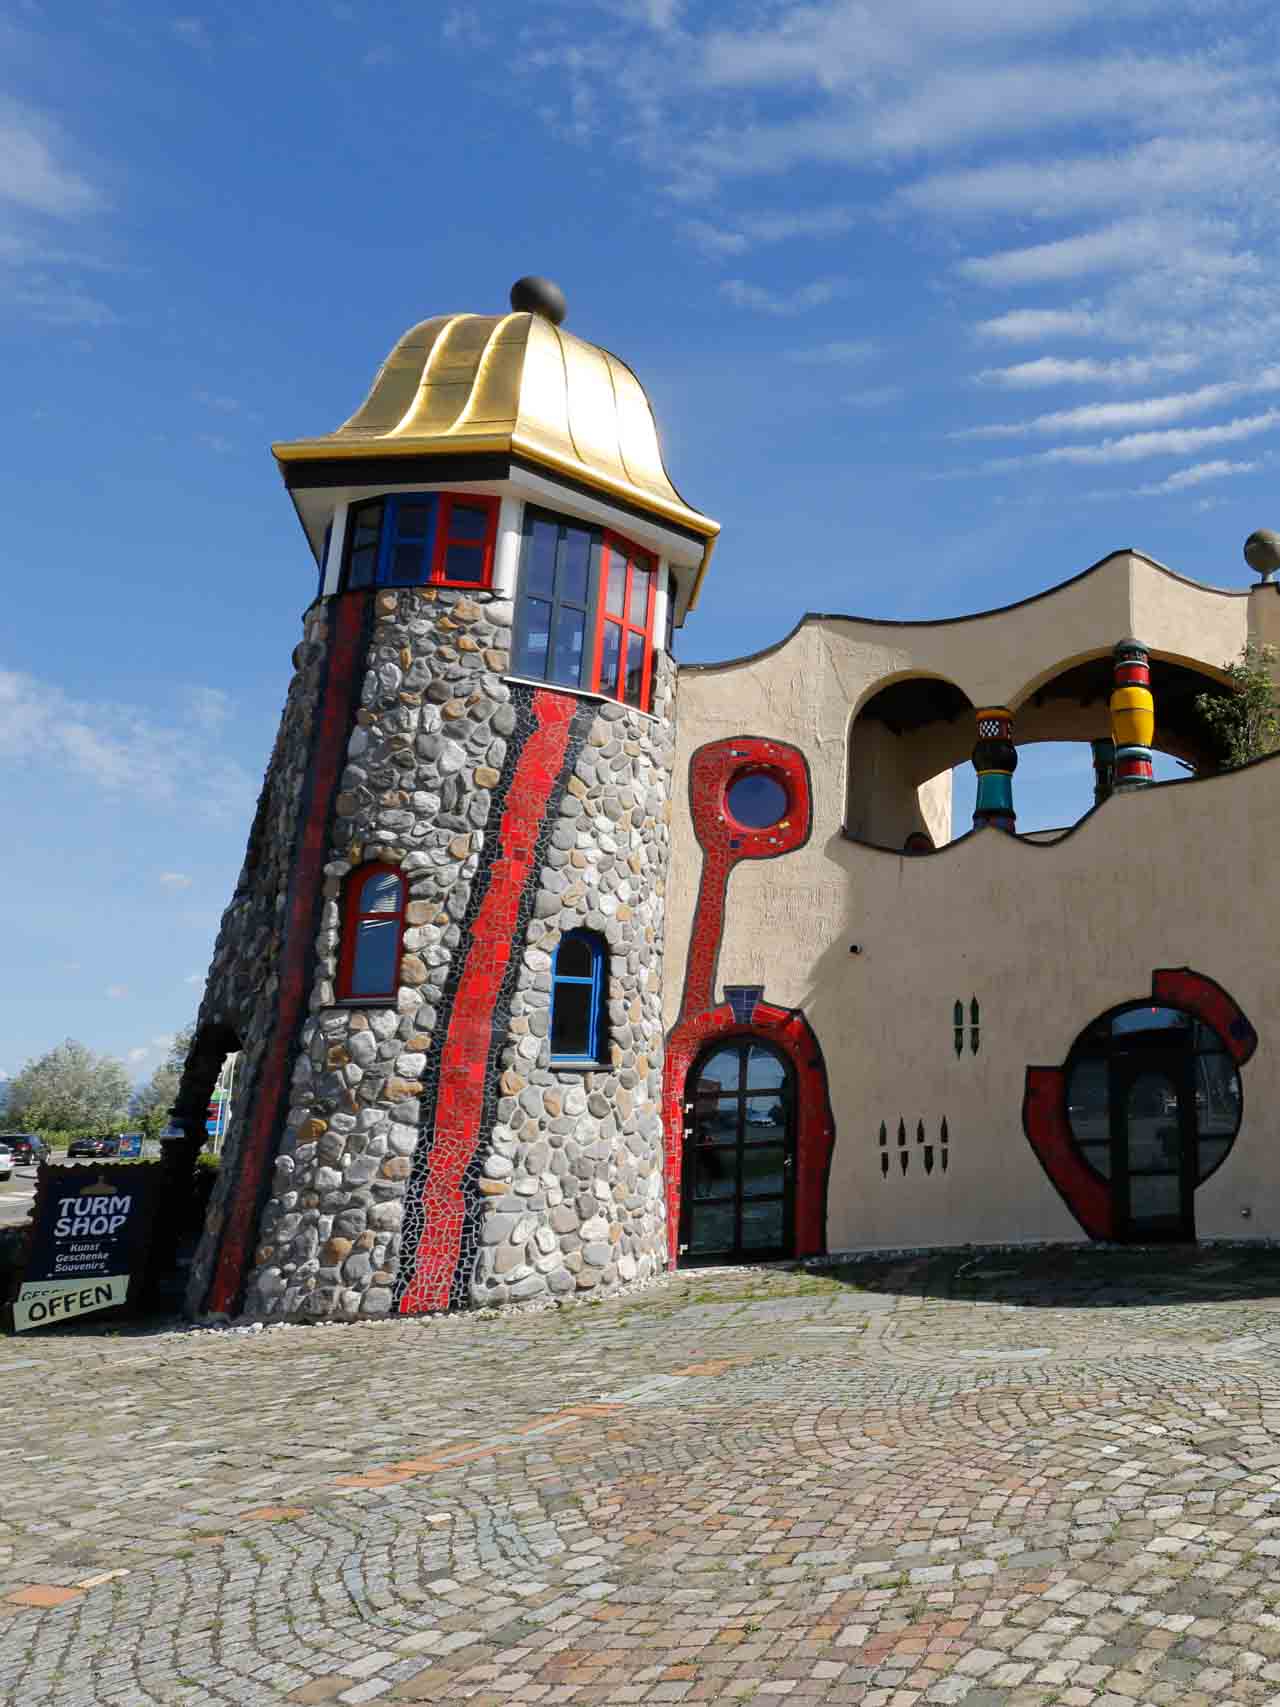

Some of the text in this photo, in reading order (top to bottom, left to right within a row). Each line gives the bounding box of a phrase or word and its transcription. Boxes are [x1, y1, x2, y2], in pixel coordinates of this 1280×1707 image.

[57, 1195, 132, 1217] TURM
[54, 1215, 127, 1237] SHOP
[69, 1242, 101, 1253] Kunst
[55, 1251, 109, 1263] Geschenke
[55, 1261, 105, 1273] Souvenirs
[28, 1284, 113, 1322] OFFEN
